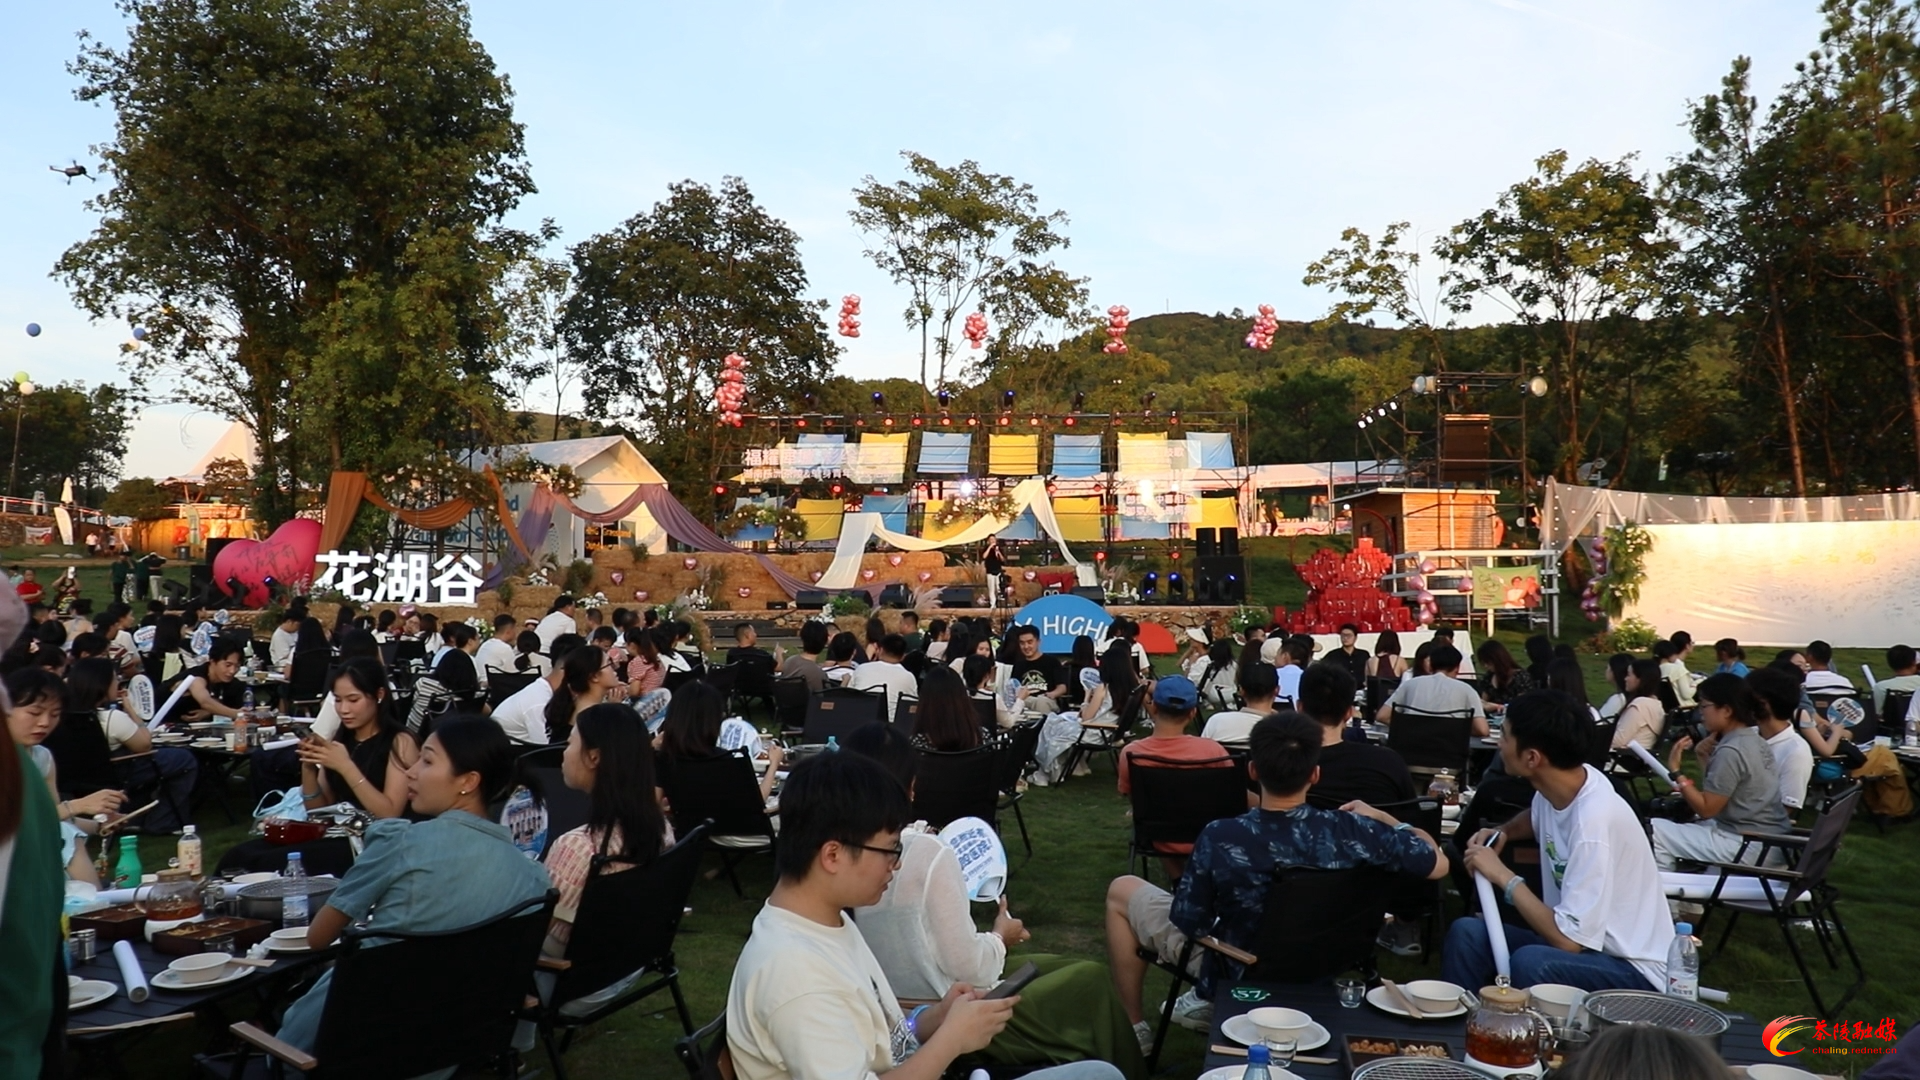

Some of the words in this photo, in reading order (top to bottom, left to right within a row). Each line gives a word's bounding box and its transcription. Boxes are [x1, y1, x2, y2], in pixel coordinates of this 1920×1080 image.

[315, 550, 484, 604] 花湖谷
[1237, 990, 1261, 998] 57
